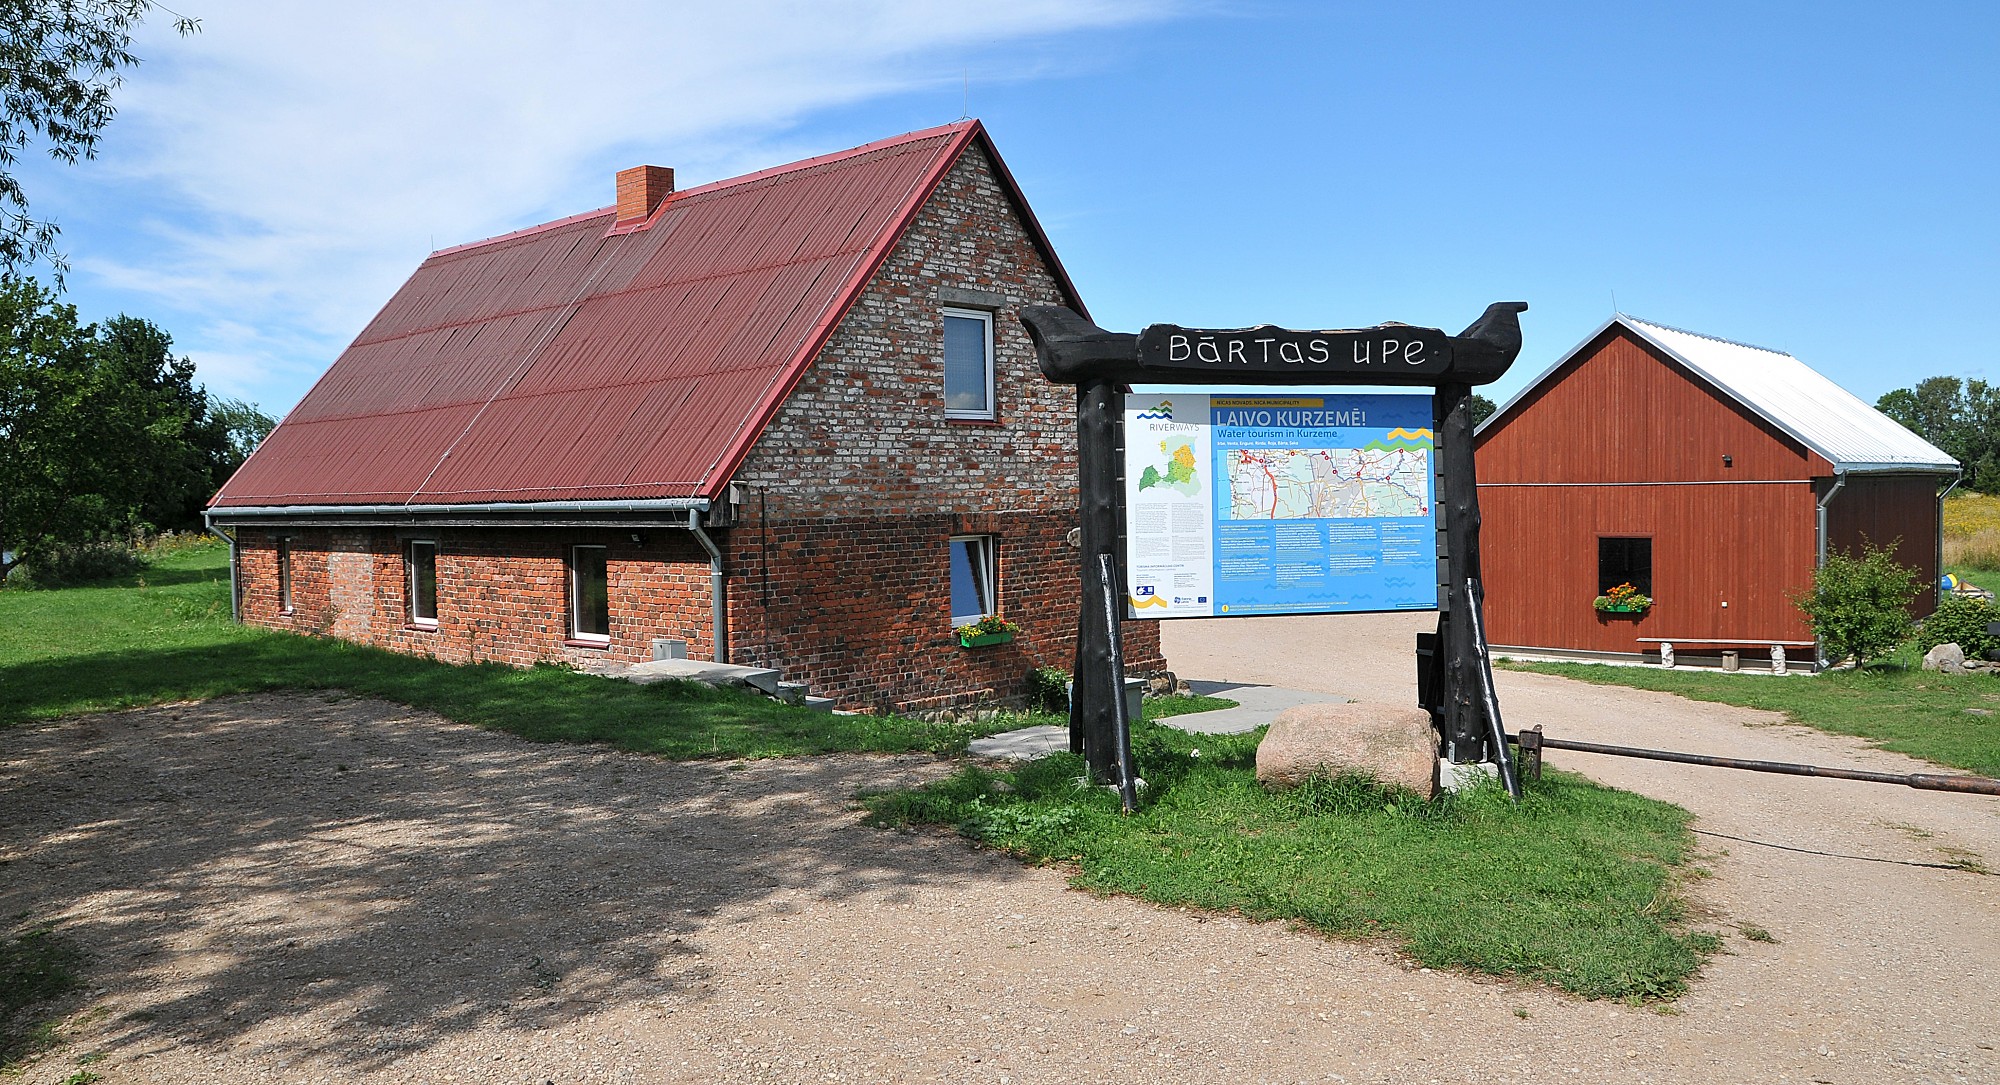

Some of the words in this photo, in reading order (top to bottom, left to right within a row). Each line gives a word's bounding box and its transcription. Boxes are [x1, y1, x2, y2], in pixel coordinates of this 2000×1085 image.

[1216, 410, 1271, 427] LAIVO
[1276, 408, 1366, 427] KURZEMĒ!
[1149, 423, 1200, 432] RIVERWAYS
[1217, 429, 1245, 438] Water
[1248, 429, 1284, 438] tourism
[1286, 429, 1295, 438] in
[1297, 429, 1338, 438] Kurzeme
